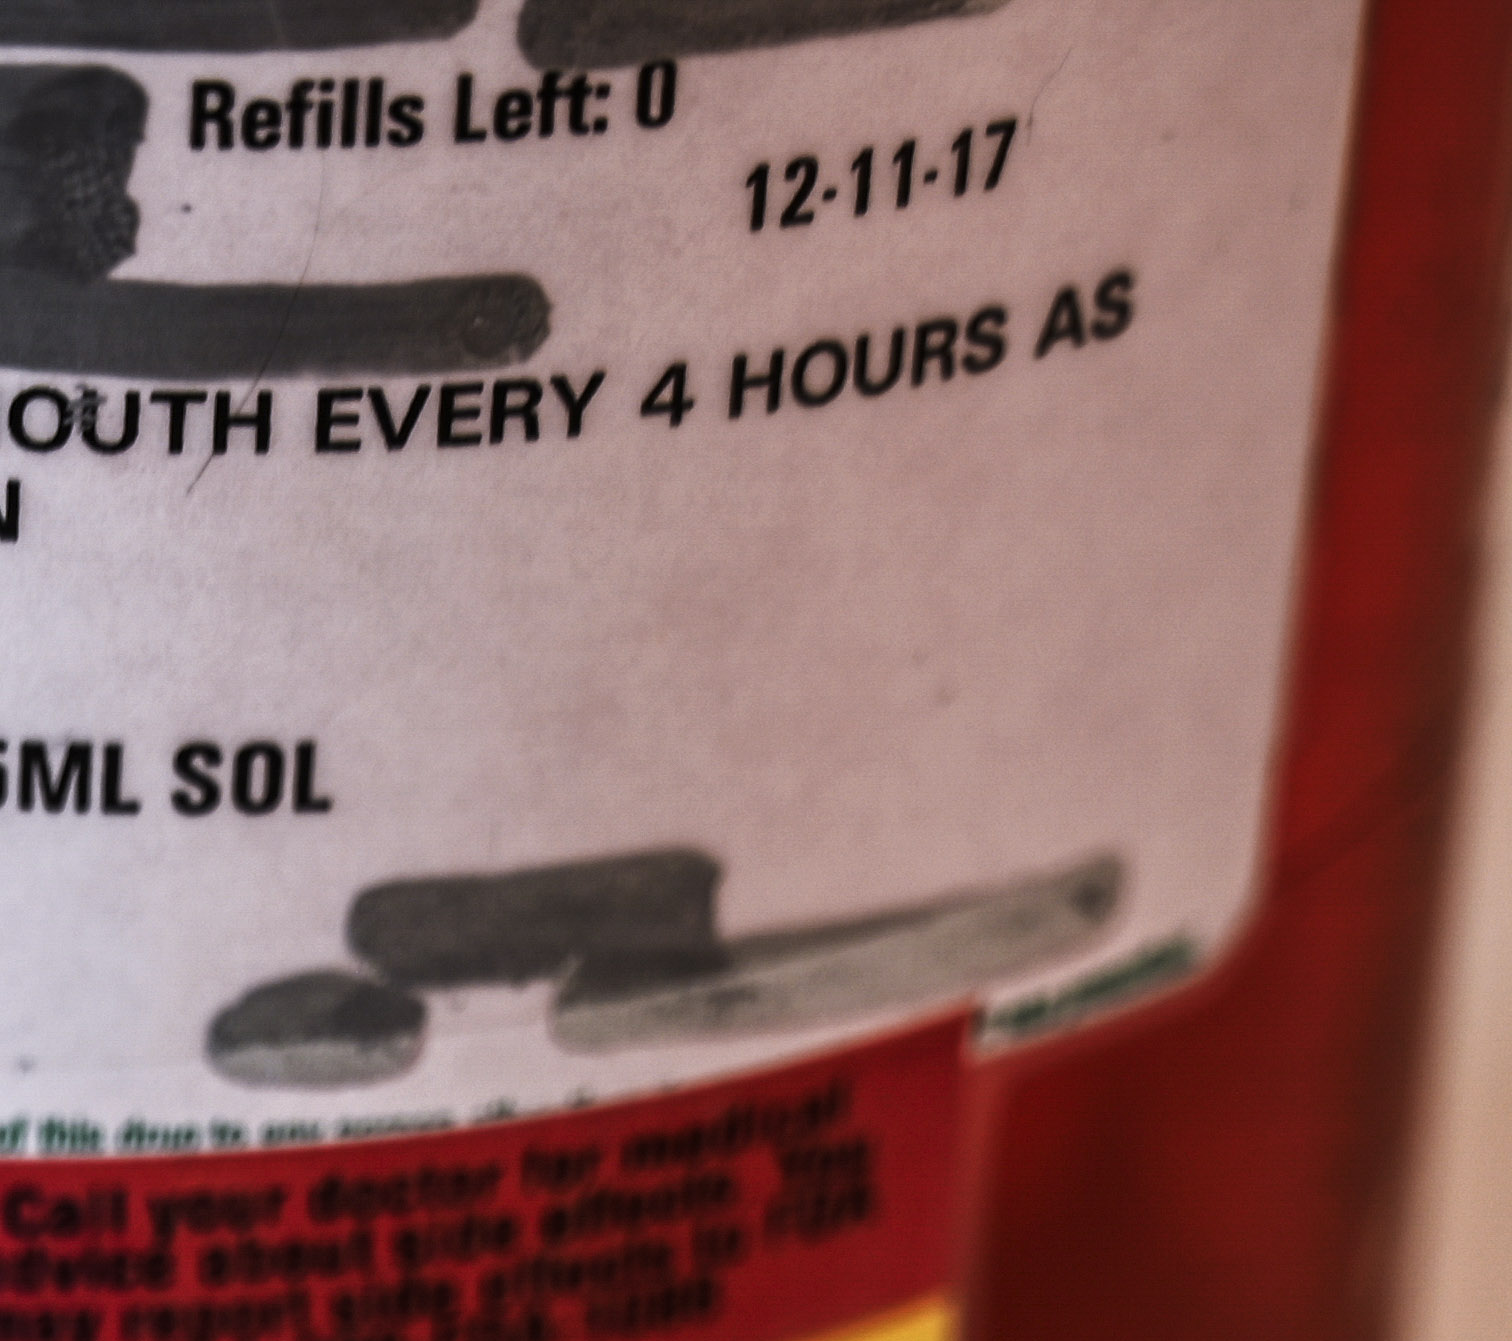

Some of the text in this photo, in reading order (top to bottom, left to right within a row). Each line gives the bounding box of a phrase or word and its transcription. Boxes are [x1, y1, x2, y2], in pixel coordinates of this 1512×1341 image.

[187, 58, 678, 154] Refills Left: 0
[743, 118, 1018, 234] 12-11-17
[315, 371, 605, 455] EVERY
[638, 363, 694, 428] 4
[727, 305, 1008, 421] HOURS
[1033, 267, 1137, 361] AS
[169, 738, 333, 817] SOL
